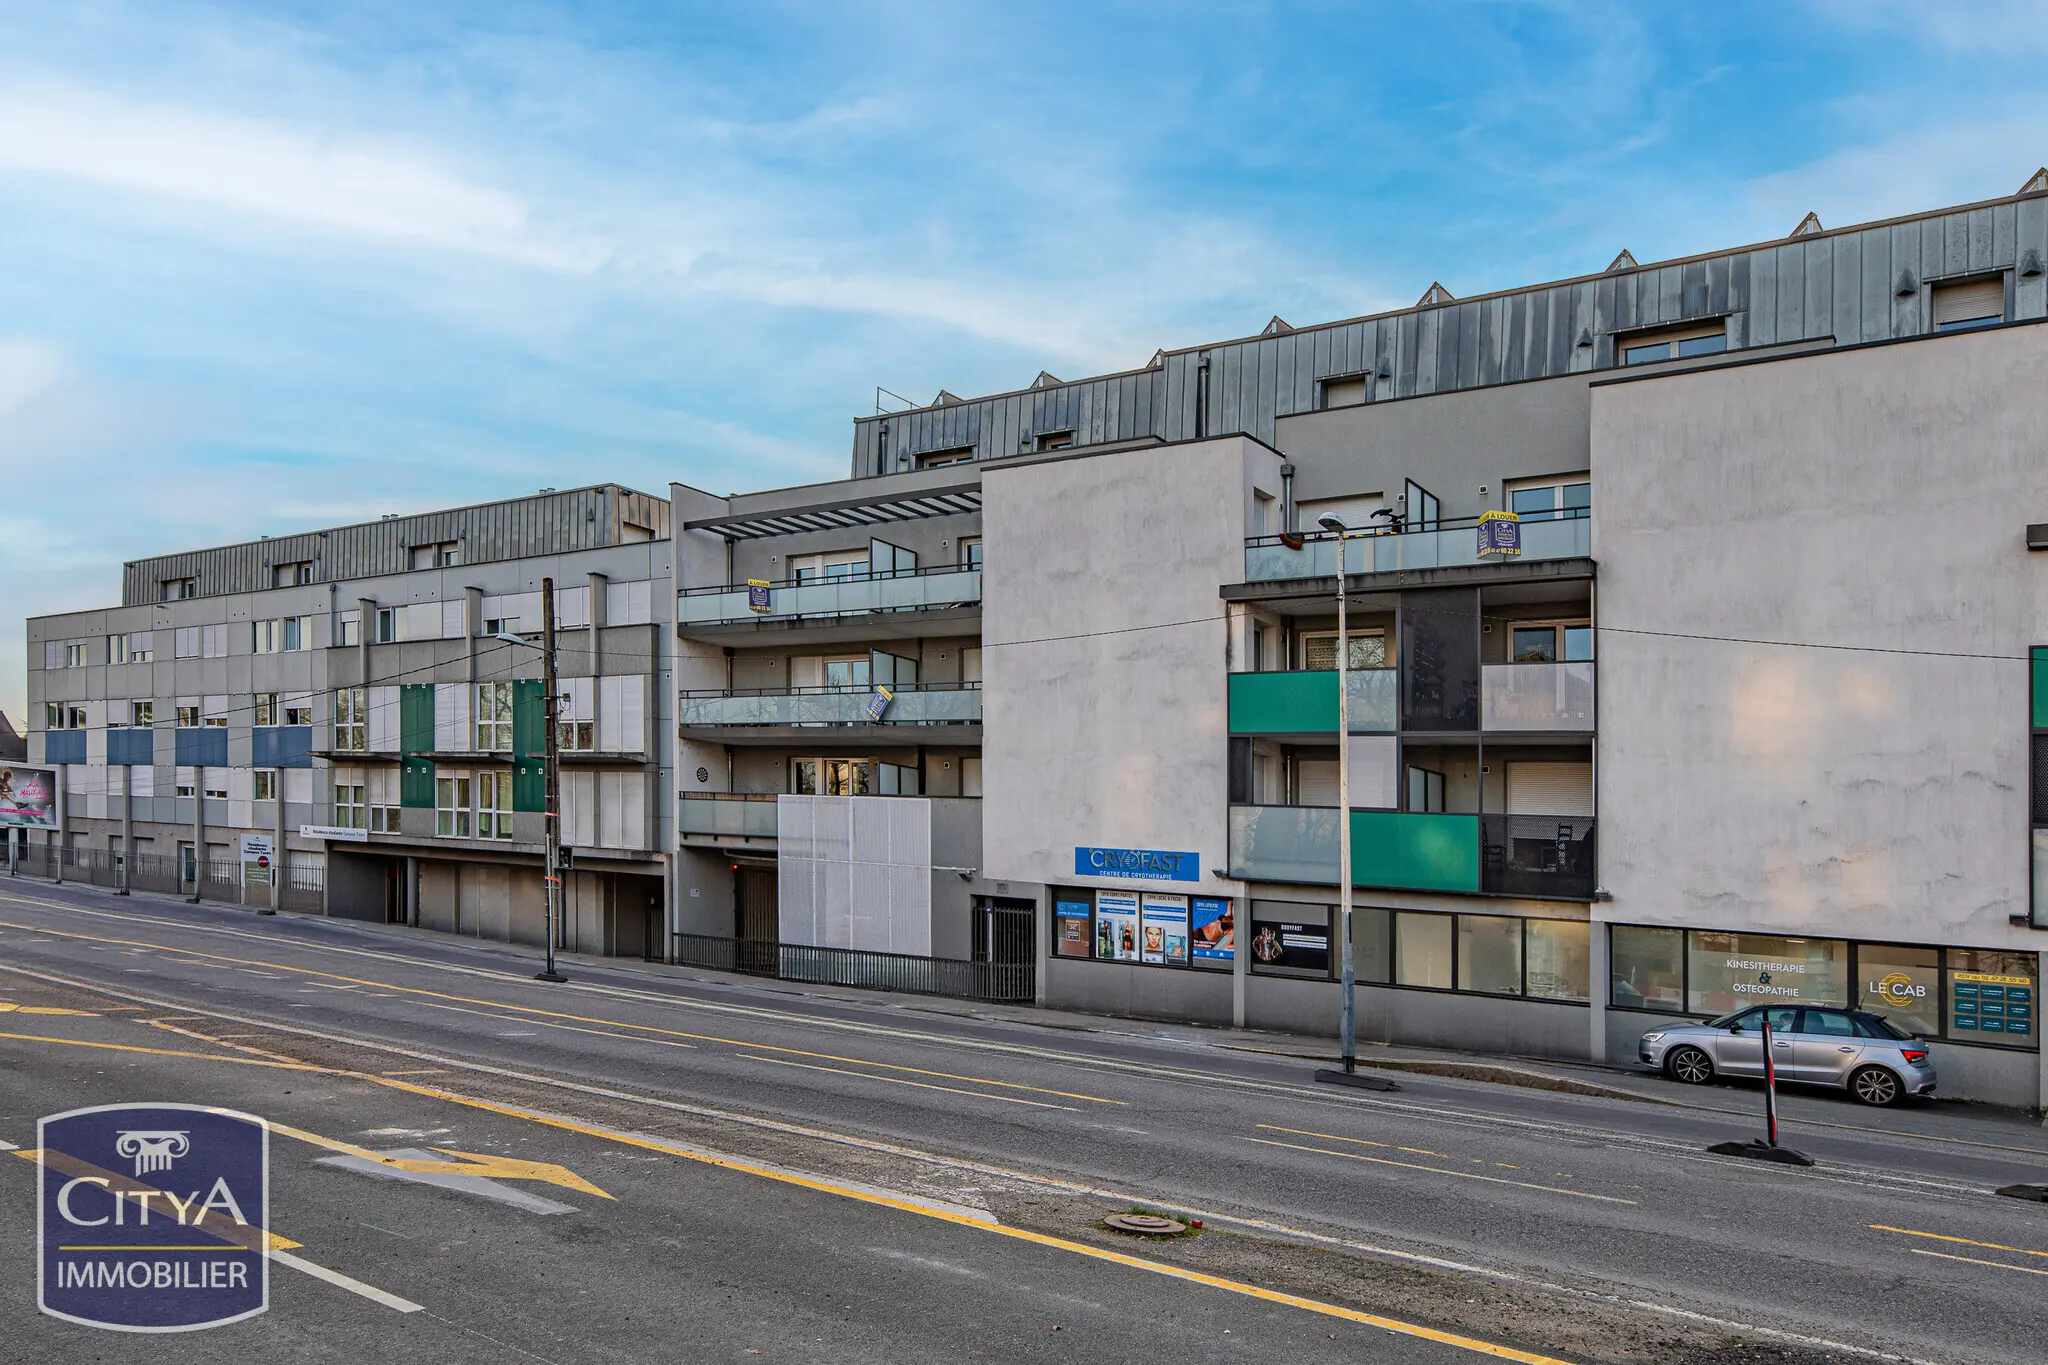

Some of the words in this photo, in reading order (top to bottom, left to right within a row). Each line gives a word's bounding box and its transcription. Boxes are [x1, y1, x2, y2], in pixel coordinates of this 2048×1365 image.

[1131, 872, 1172, 880] CRYOTHERAPIE
[1726, 960, 1805, 973] KINESITHERAPIE
[1759, 972, 1772, 984] &
[1733, 983, 1799, 997] OSTEOPATHIE
[1870, 982, 1887, 994] LE
[1892, 983, 1926, 997] CAB
